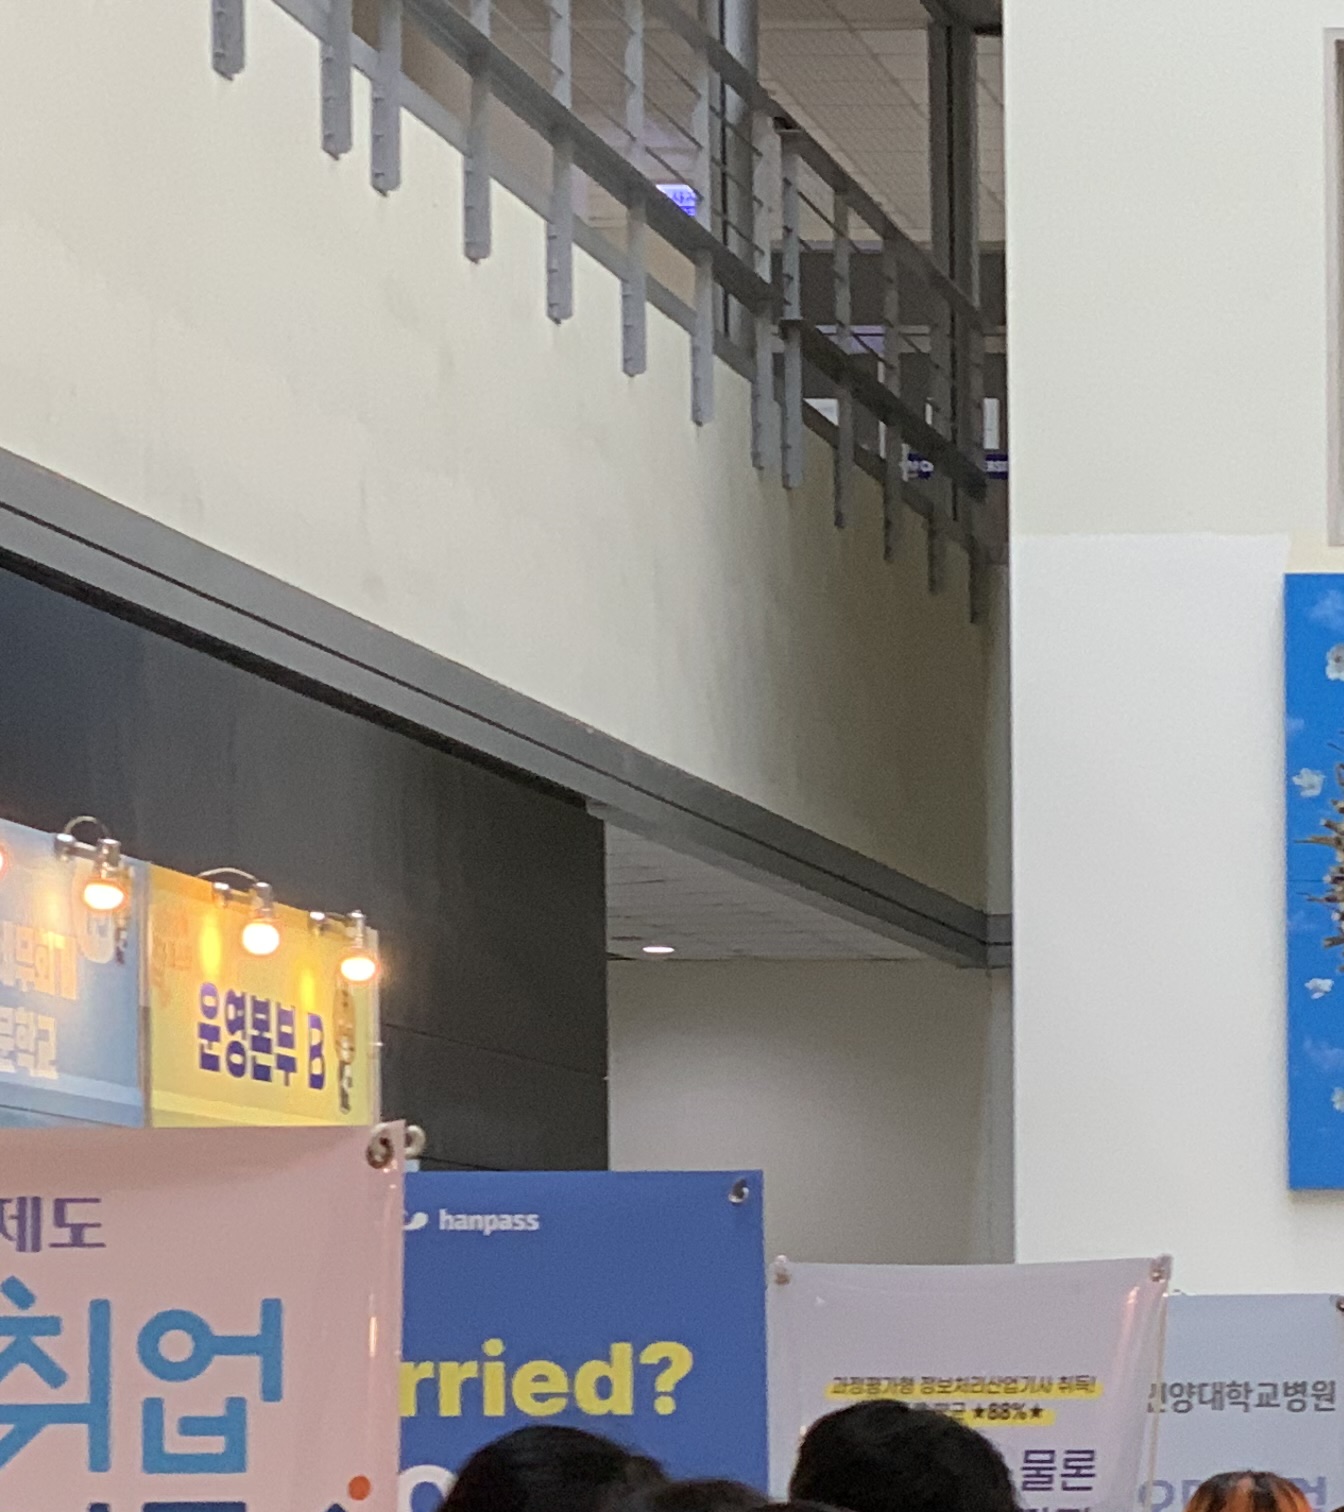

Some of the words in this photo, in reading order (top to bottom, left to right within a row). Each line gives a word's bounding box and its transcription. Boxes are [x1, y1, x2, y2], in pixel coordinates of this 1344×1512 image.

[197, 982, 297, 1087] 운영본부
[439, 1209, 540, 1237] hanpass
[0, 1276, 284, 1474] 취업
[1020, 1449, 1096, 1492] 물론
